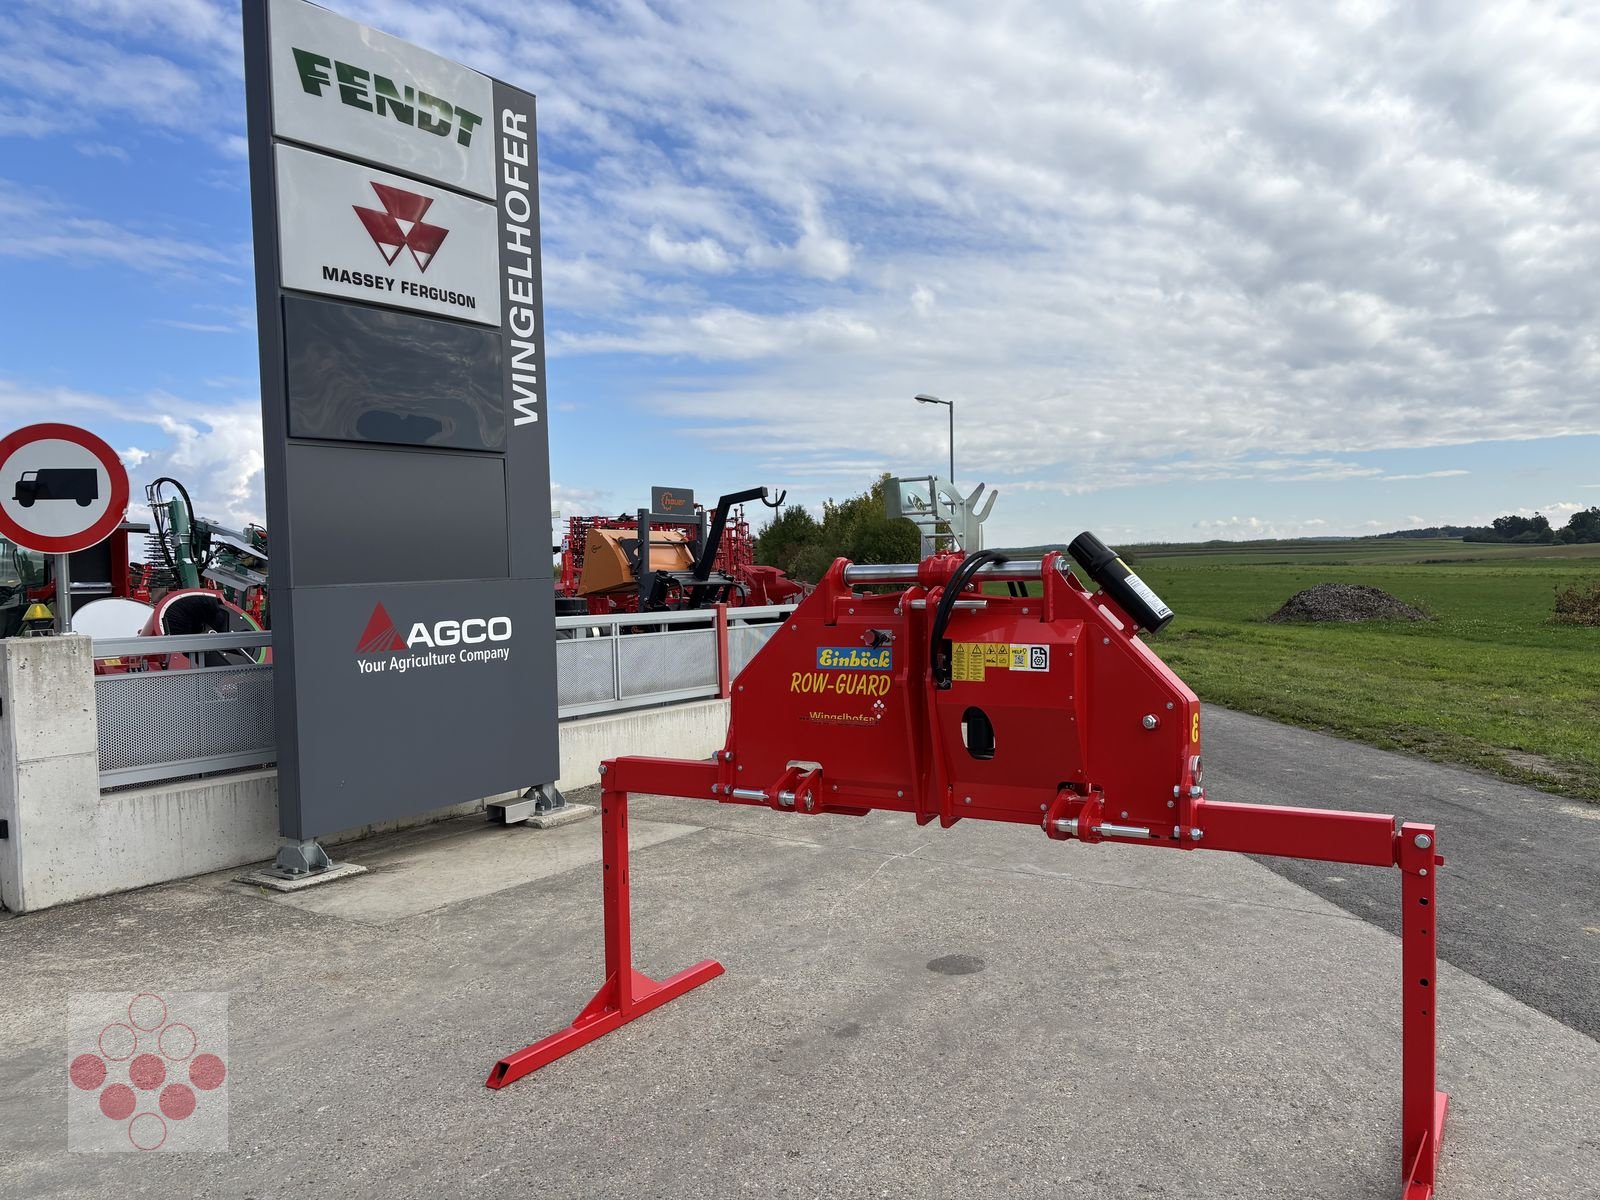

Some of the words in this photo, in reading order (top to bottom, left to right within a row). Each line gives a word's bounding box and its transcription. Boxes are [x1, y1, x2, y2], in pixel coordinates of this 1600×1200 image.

[292, 47, 482, 148] FENDT
[502, 108, 538, 426] WINGELHOFER
[322, 265, 395, 292] MASSEY
[401, 280, 476, 309] FERGUSON
[406, 616, 512, 649] AGCO
[357, 659, 387, 674] Your
[389, 652, 456, 673] Agriculture
[459, 647, 510, 663] Company
[819, 649, 891, 668] Einböck
[790, 672, 891, 697] ROW-GUARD
